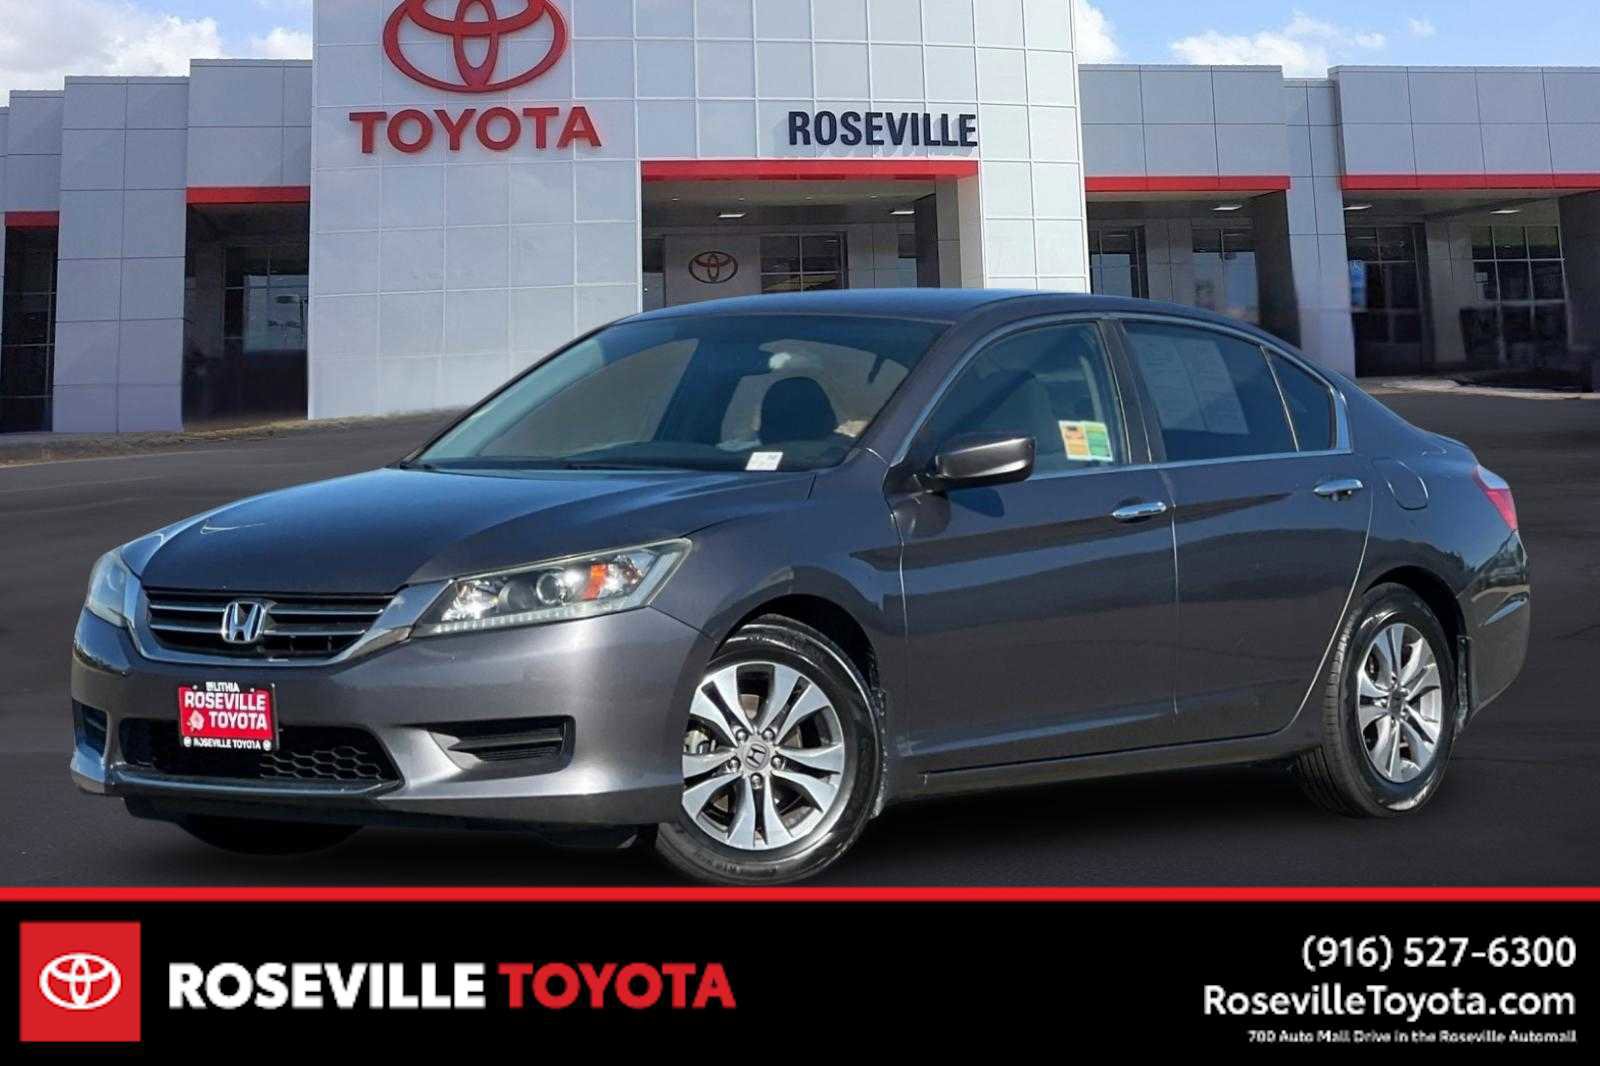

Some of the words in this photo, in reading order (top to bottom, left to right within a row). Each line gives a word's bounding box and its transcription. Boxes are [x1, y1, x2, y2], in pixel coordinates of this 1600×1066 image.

[350, 106, 602, 154] TOYOTA
[788, 110, 978, 147] ROSEVILLE
[184, 691, 266, 711] ROSEVILLE
[209, 711, 268, 730] TOYOTA
[232, 739, 261, 750] TOYOTA
